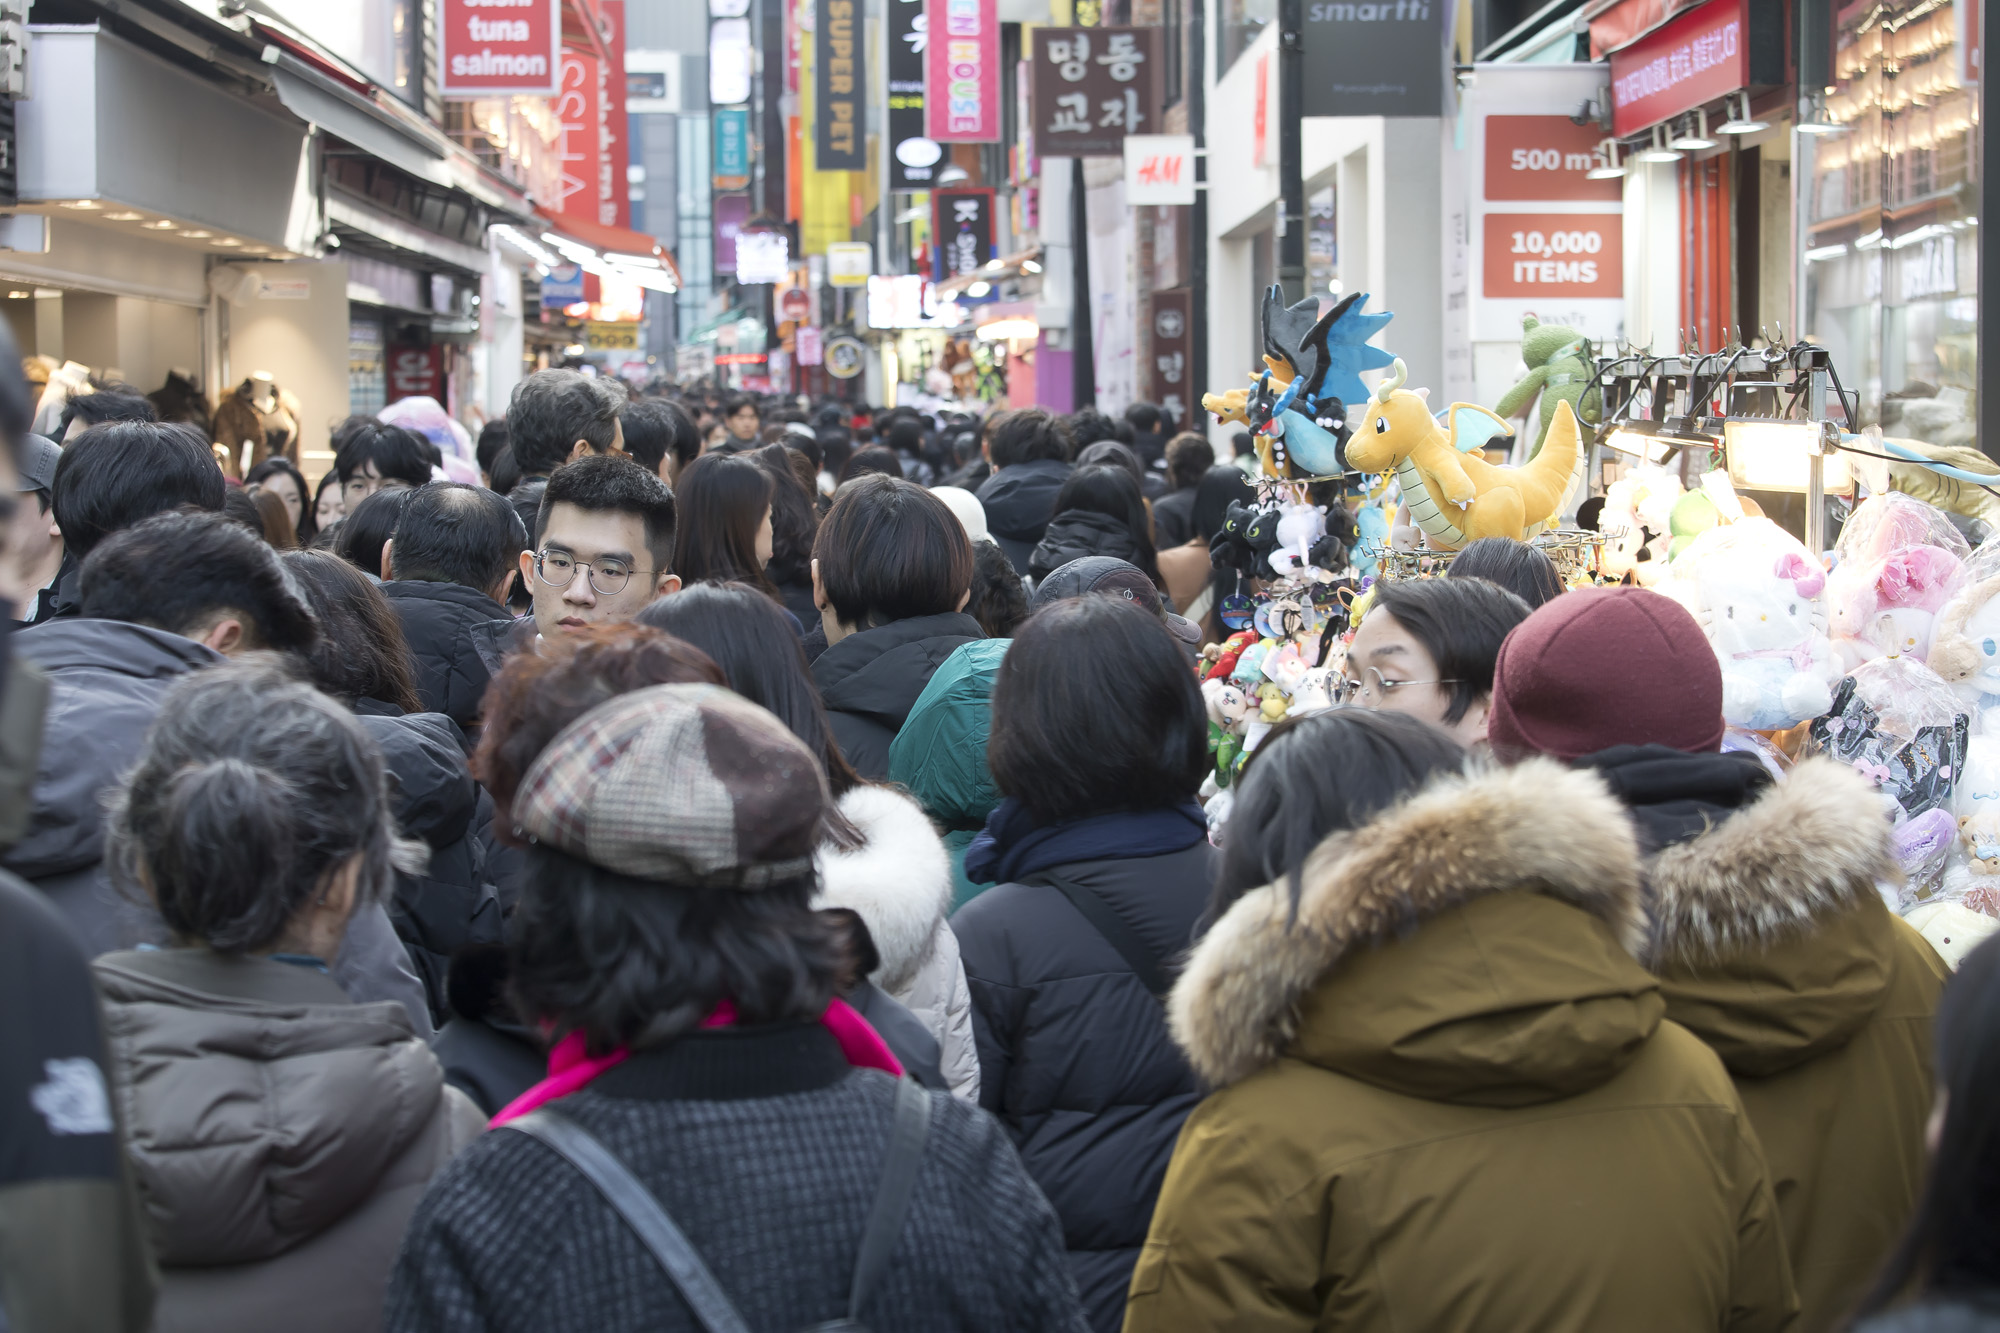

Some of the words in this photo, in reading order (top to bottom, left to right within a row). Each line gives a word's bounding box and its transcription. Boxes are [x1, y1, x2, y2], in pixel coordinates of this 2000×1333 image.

[467, 14, 530, 41] tuna
[451, 48, 546, 76] salmon
[829, 0, 853, 94] SUPER
[1047, 33, 1145, 82] 명동
[949, 39, 982, 132] HOUSE
[829, 102, 853, 155] PET
[1047, 88, 1145, 134] 교자
[1511, 148, 1561, 171] 500
[1511, 231, 1602, 259] 10,000
[1513, 260, 1598, 283] ITEMS
